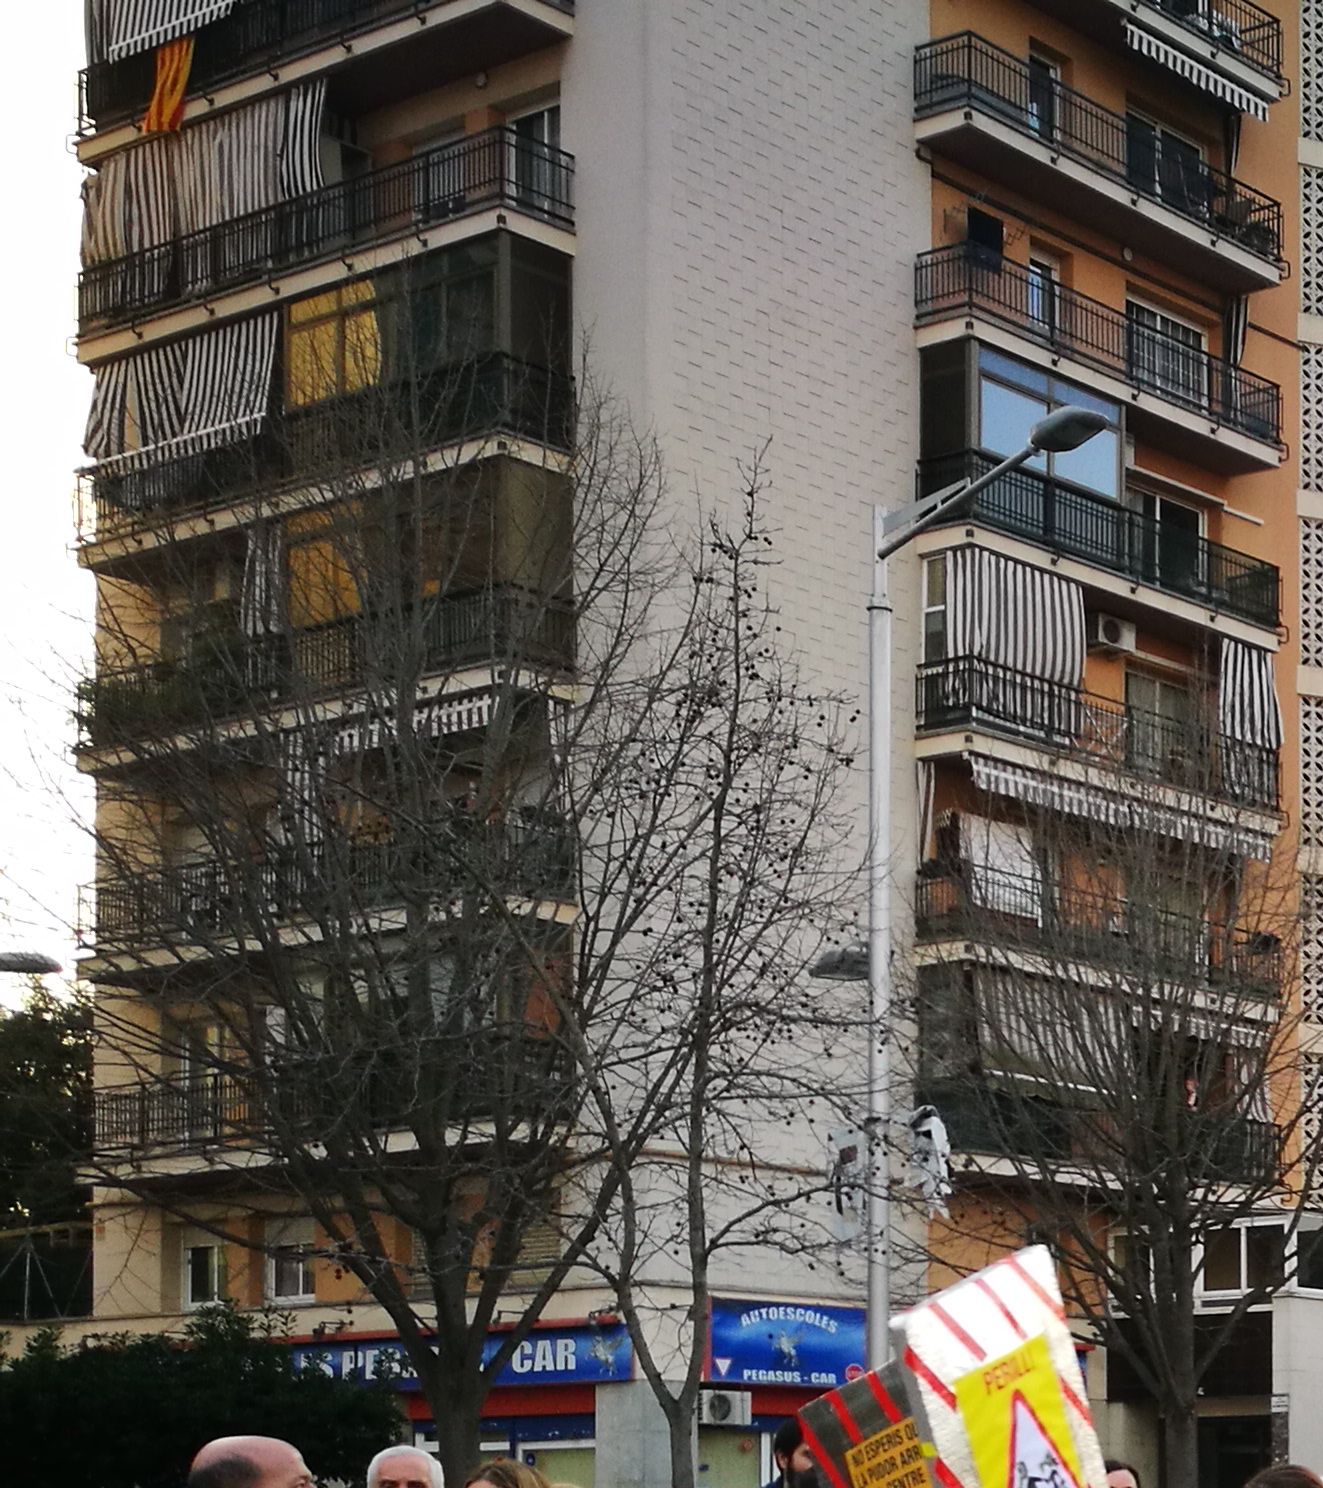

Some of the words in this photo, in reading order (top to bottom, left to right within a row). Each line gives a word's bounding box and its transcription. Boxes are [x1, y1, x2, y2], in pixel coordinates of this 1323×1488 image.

[740, 1306, 838, 1334] AUTOESCOLES
[511, 1338, 576, 1373] CAR
[743, 1369, 801, 1383] PEGASUS
[810, 1371, 837, 1384] CAR
